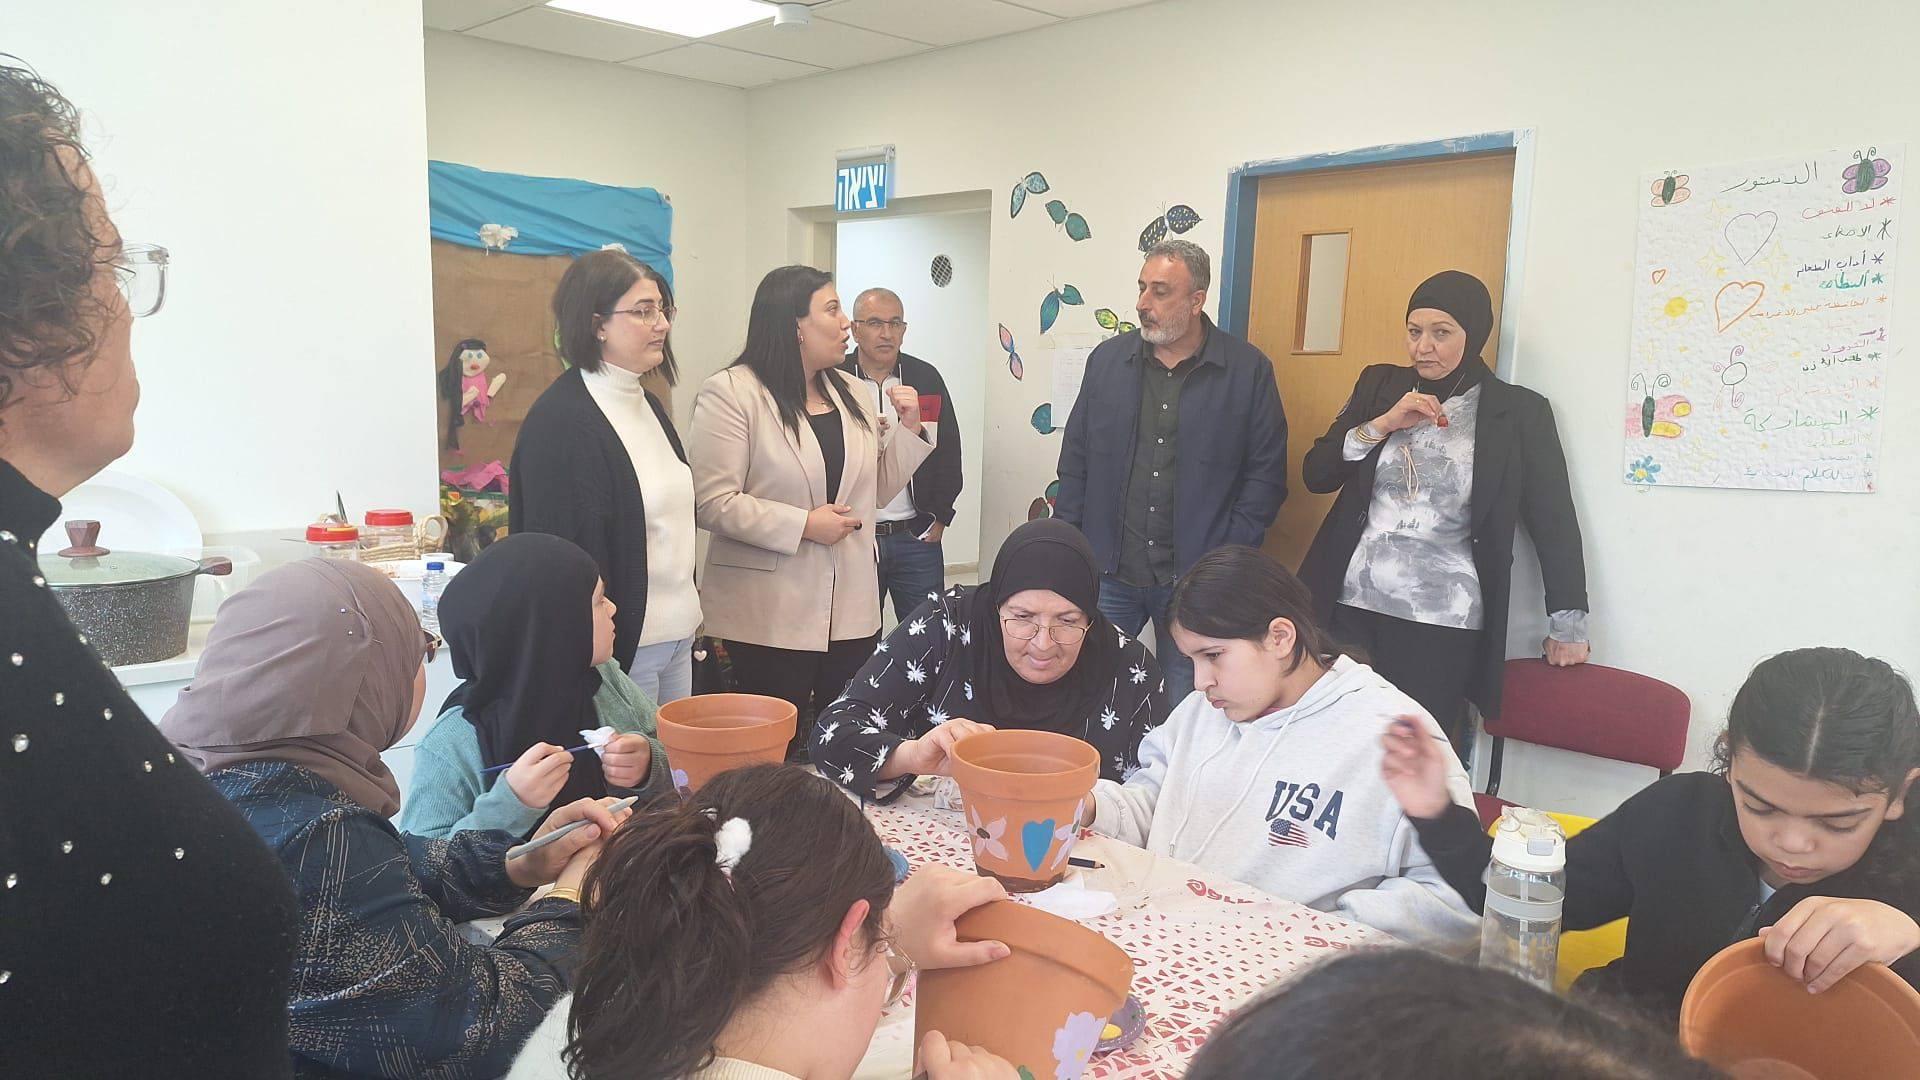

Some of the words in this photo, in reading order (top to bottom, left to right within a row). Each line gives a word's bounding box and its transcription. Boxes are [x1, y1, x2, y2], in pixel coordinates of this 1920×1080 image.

[838, 164, 885, 211] יציאה
[1720, 160, 1818, 193] الدستور
[1265, 780, 1344, 841] USA
